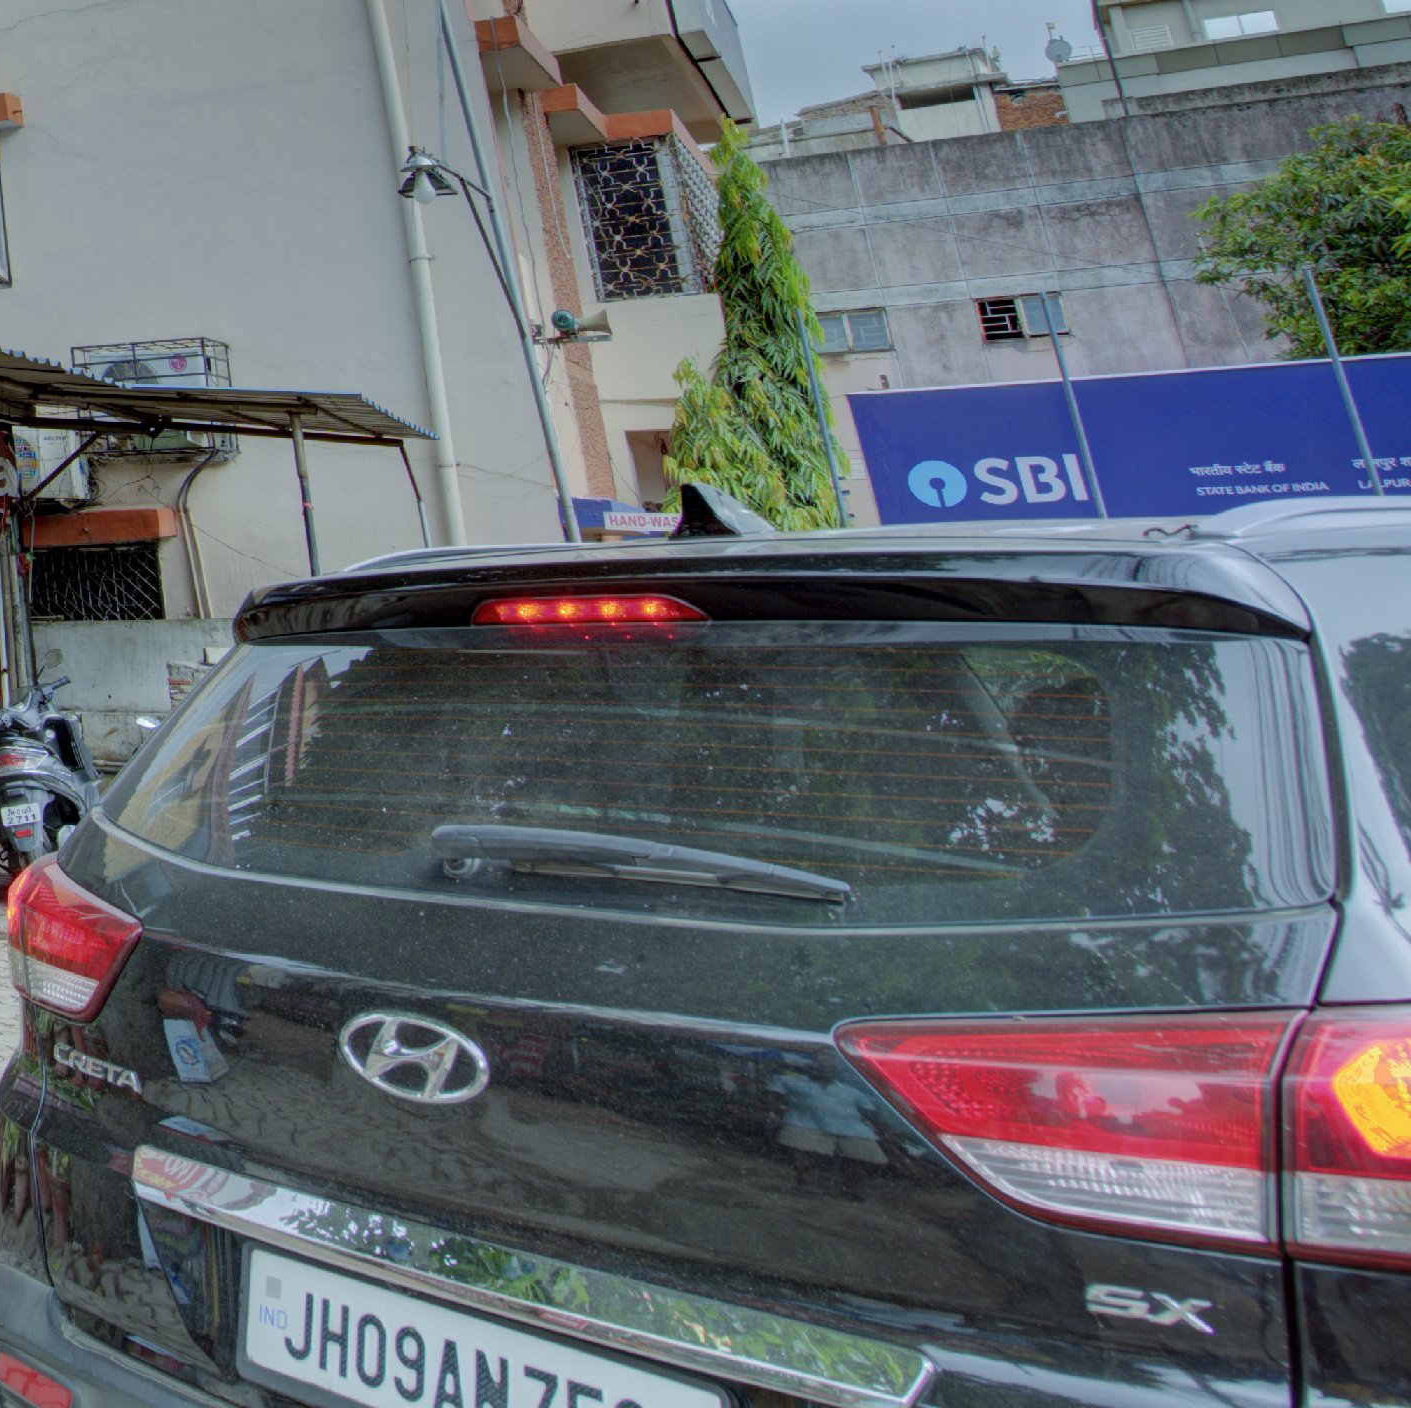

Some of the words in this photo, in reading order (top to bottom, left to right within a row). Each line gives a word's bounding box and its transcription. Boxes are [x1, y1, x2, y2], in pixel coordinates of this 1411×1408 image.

[973, 453, 1090, 505] SBI
[1189, 464, 1232, 477] भारतीय
[1196, 485, 1235, 497] STATE
[1236, 483, 1271, 495] BANK
[1271, 483, 1290, 493] OF
[1292, 481, 1330, 493] INDIA
[53, 1041, 143, 1095] CRETA
[257, 1302, 288, 1331] IND
[1085, 1282, 1215, 1335] SX
